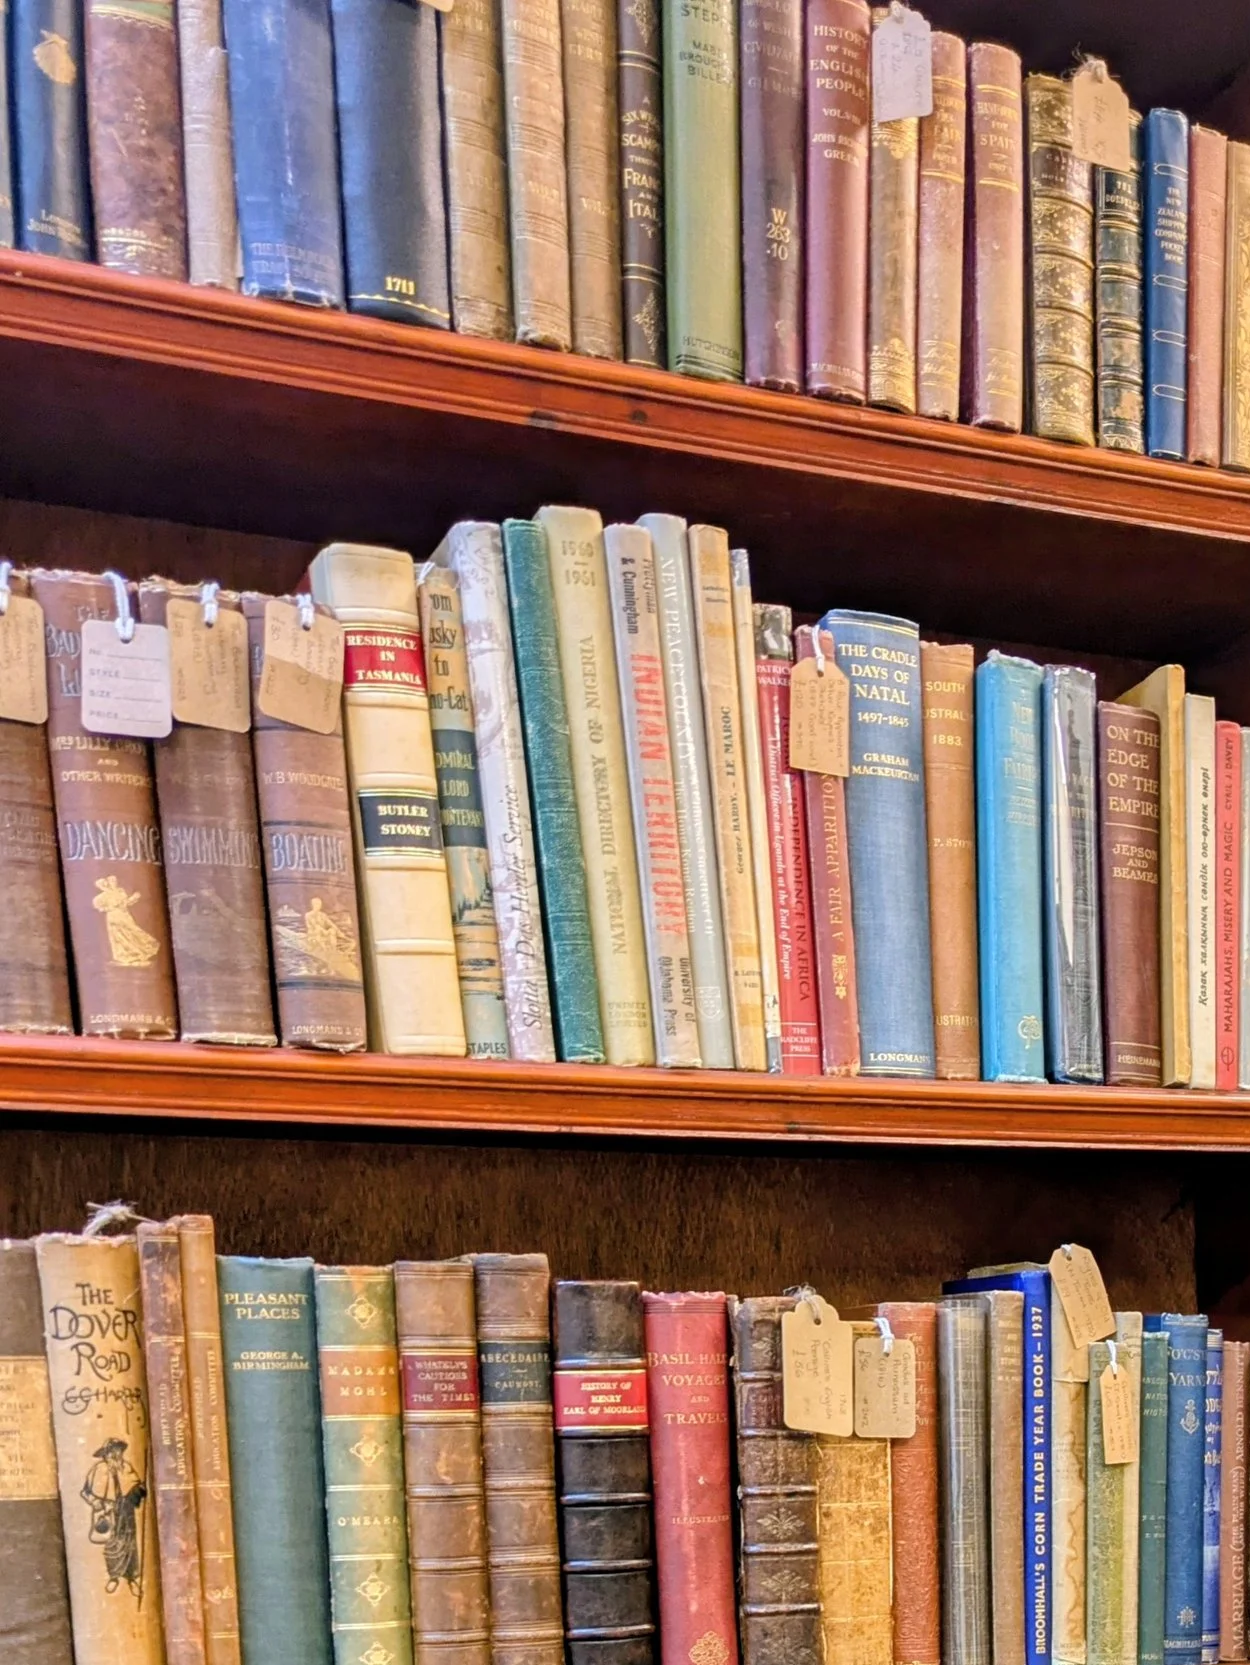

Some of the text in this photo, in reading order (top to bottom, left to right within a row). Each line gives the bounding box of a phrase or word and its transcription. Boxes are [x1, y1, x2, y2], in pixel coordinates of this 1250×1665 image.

[772, 208, 788, 224] W
[766, 223, 791, 242] 263
[347, 634, 418, 650] RESIDENCE
[381, 649, 394, 662] IN
[837, 644, 918, 667] THE CRADLE
[355, 669, 422, 685] TASMANIA
[851, 664, 909, 683] DAYS OF
[853, 683, 911, 706] NATAL
[1107, 725, 1160, 746] ON THE
[1107, 748, 1149, 769] EDGE
[1108, 774, 1159, 793] OF THE
[579, 635, 626, 955] NATIONAL DIRECTORY OF NIGERIA
[378, 804, 429, 817] BUTLER
[1109, 797, 1160, 818] EMPIRE
[380, 823, 431, 837] STONEY
[66, 822, 161, 863] DANCING
[271, 834, 346, 873] BOATING
[1127, 858, 1149, 869] AND
[1224, 822, 1234, 1032] MAHARAJAHS, MISERY AND MAGIC
[76, 1283, 113, 1305] THE
[225, 1293, 308, 1306] PLEASANT
[236, 1307, 300, 1320] PLACES
[50, 1306, 139, 1344] DOVER
[75, 1342, 130, 1382] ROAD
[1032, 1306, 1047, 1655] BROOMHALL'S CORN TRADE YEAR BOOK 1937
